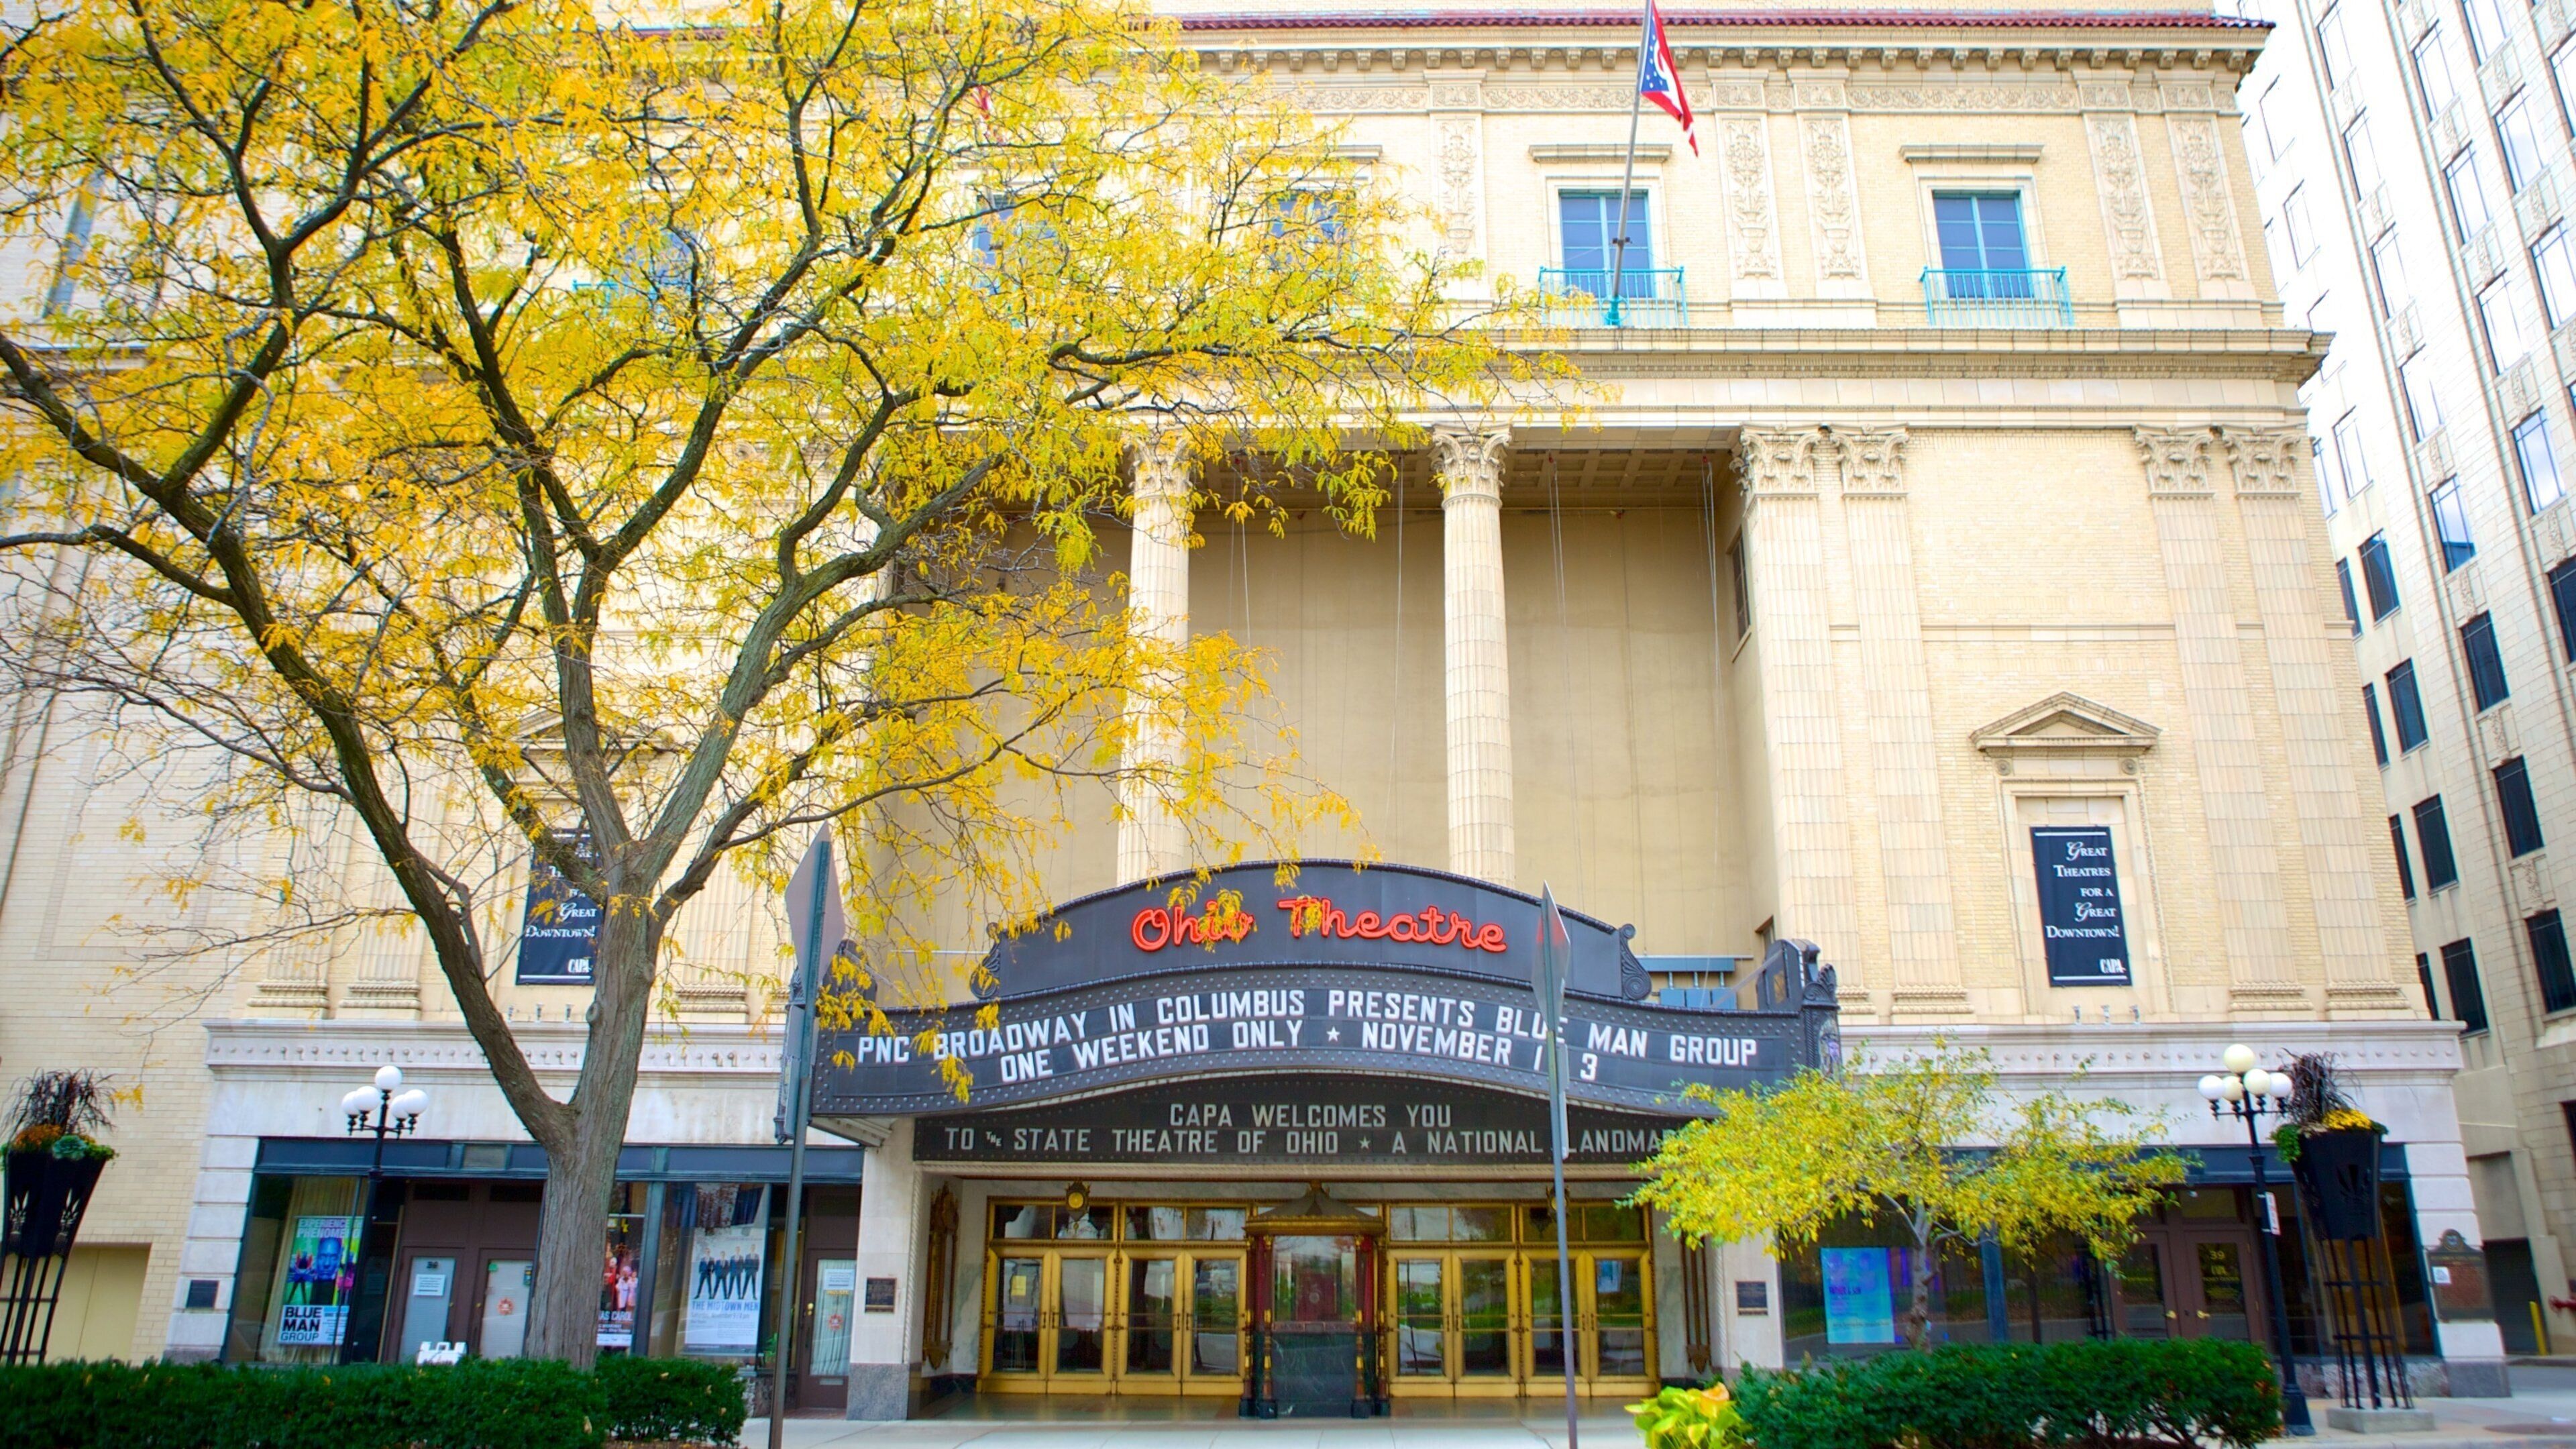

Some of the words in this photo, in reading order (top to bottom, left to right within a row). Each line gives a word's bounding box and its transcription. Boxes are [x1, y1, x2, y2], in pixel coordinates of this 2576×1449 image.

[2066, 841, 2108, 861] GREAT
[2053, 865, 2111, 877] THEATRES
[2080, 888, 2103, 897] FOR
[2105, 888, 2114, 897] A
[559, 902, 597, 922] GREAT
[2075, 902, 2116, 922] GREAT
[525, 925, 595, 938] DOWNTOWN!
[1132, 900, 1254, 951] Ohio
[1277, 897, 1507, 953] Theatre
[2045, 925, 2120, 938] DOWNTOWN!
[568, 959, 592, 973] CAPA
[2100, 959, 2126, 973] CAPA
[858, 1036, 910, 1063] PNC
[933, 1011, 1087, 1061] BROADWAY
[1109, 1003, 1136, 1032] IN
[1157, 989, 1305, 1024] COLUMBUS
[1328, 989, 1475, 1028] PRESENTS
[1496, 1006, 1568, 1044] BLUE
[1587, 1022, 1648, 1058] MAN
[1669, 1034, 1757, 1066] GROUP
[1000, 1049, 1053, 1083] ONE
[1072, 1024, 1210, 1069] WEEKEND
[1232, 1019, 1303, 1048] ONLY
[1362, 1021, 1512, 1067] NOVEMBER
[1170, 1104, 1232, 1126] CAPA
[1252, 1104, 1386, 1128] WELCOMES
[1406, 1104, 1452, 1128] YOU
[945, 1128, 974, 1150] TO
[986, 1131, 1002, 1146] THE
[1014, 1128, 1091, 1151] STATE
[1112, 1129, 1218, 1153] THEATRE
[1237, 1130, 1267, 1154] OF
[1286, 1130, 1338, 1154] OHIO
[1391, 1130, 1407, 1154] A
[1427, 1130, 1543, 1154] NATIONAL
[1568, 1128, 1675, 1153] ANDMA
[2210, 1250, 2226, 1260] 39
[285, 1307, 323, 1318] BLUE
[692, 1301, 704, 1310] THE
[707, 1301, 742, 1311] MIDTOWN
[744, 1301, 759, 1311] MEN
[282, 1319, 321, 1332] MAN
[280, 1332, 319, 1342] GROUP
